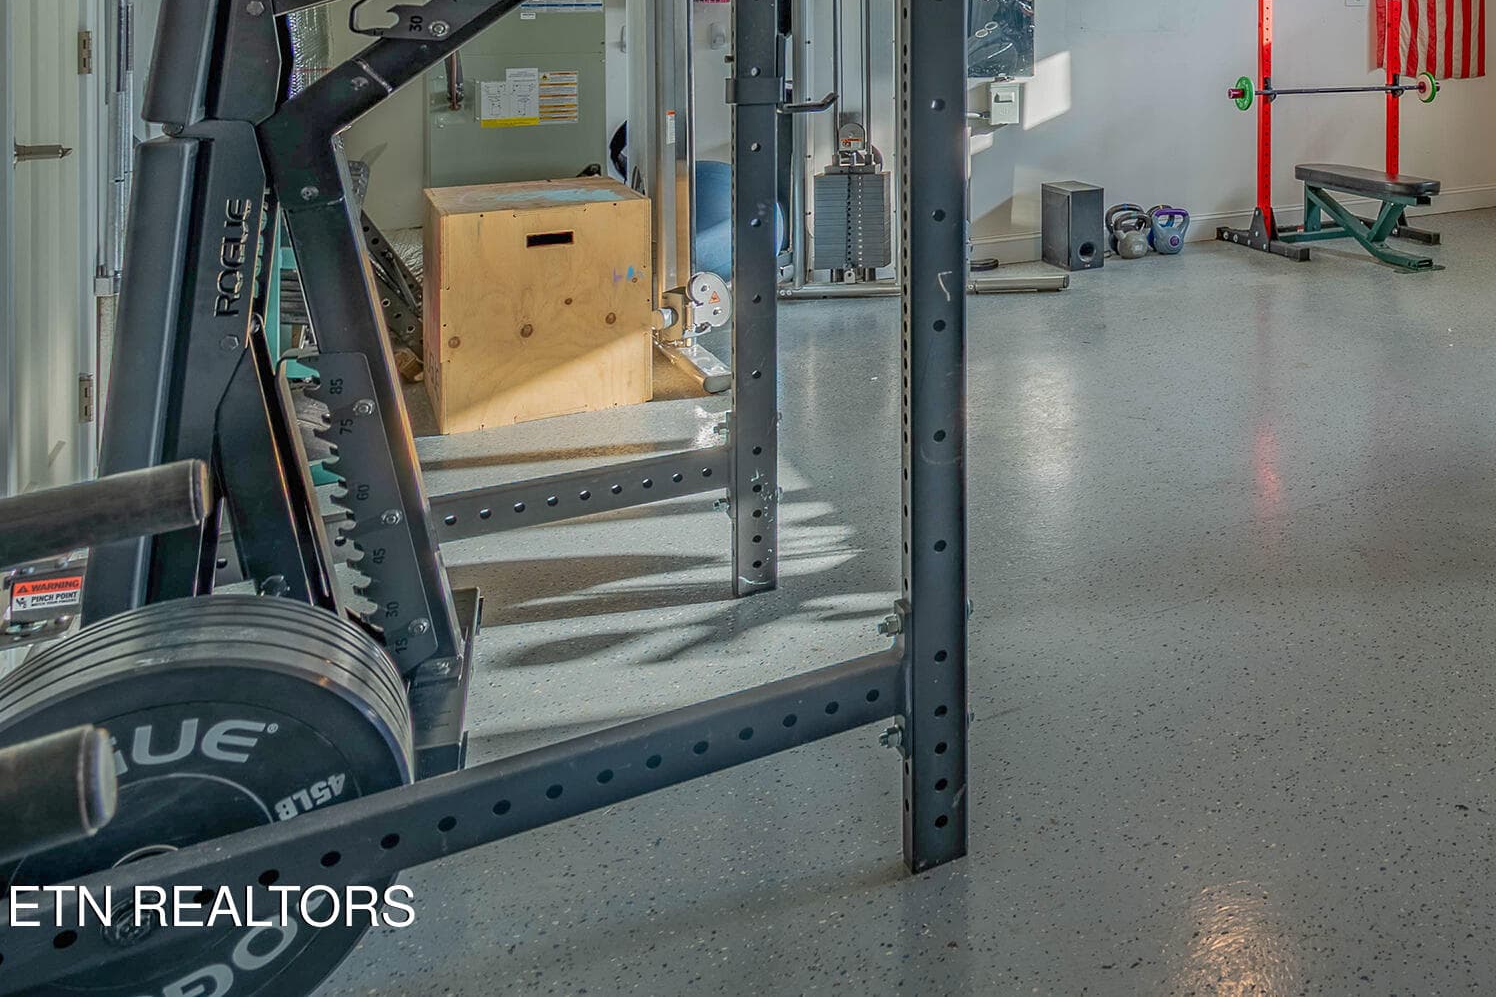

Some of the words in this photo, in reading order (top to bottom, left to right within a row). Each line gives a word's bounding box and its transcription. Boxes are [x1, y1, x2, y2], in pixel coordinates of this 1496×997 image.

[409, 15, 423, 32] 30
[213, 199, 252, 317] ROGUE
[329, 378, 343, 395] 85
[339, 418, 353, 435] 75
[356, 484, 370, 501] 60
[372, 548, 386, 564] 45
[31, 580, 79, 591] WARNING
[31, 594, 54, 603] PINCH
[55, 591, 77, 600] POINT
[386, 601, 400, 618] 30
[396, 637, 409, 654] 15
